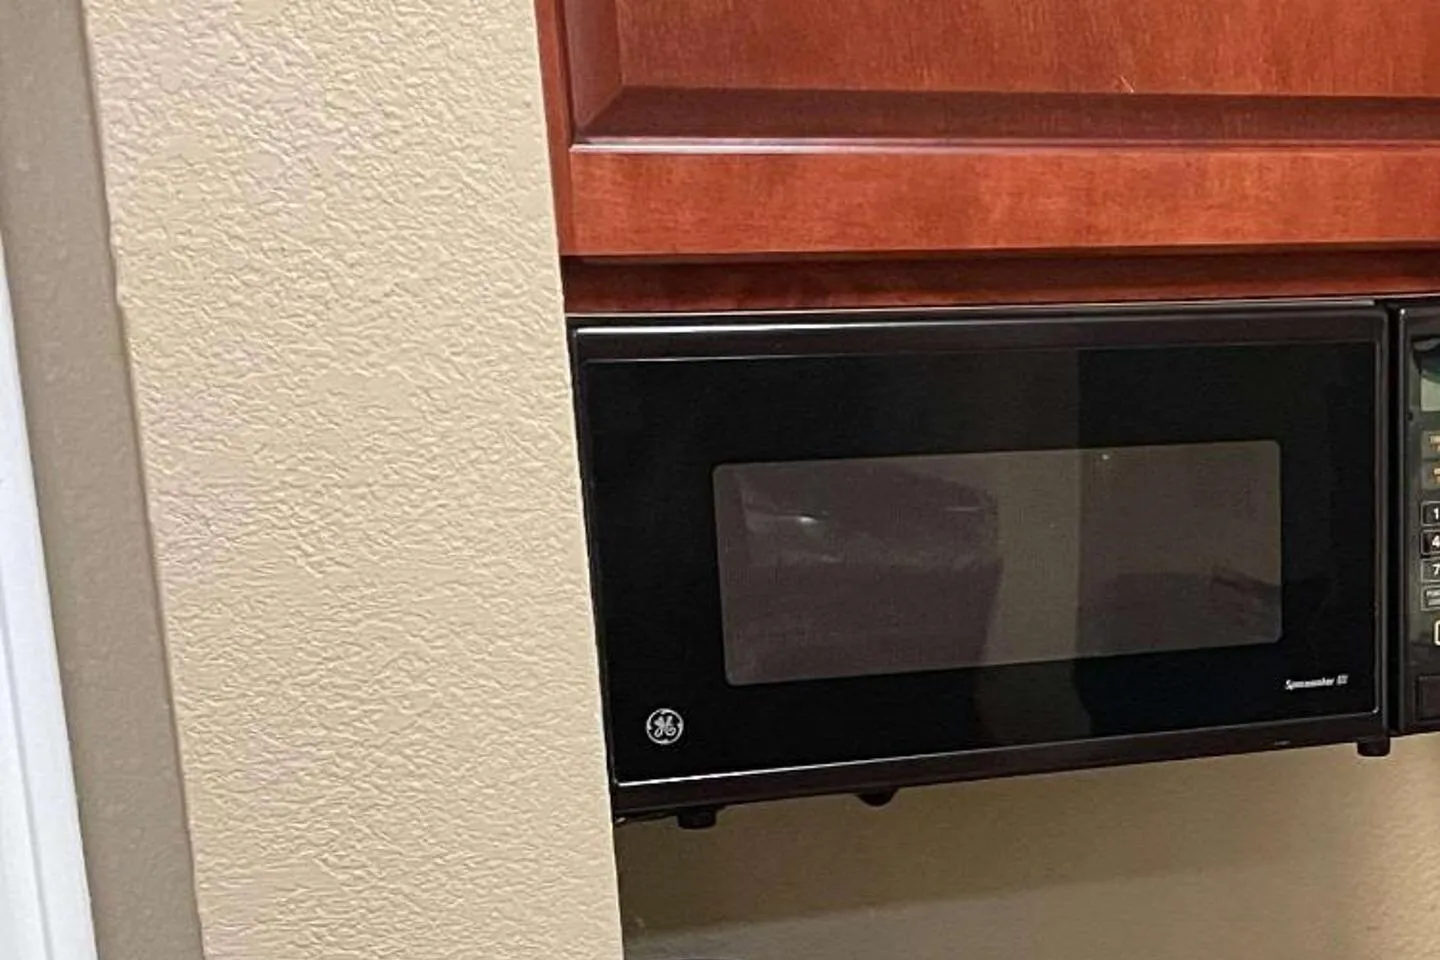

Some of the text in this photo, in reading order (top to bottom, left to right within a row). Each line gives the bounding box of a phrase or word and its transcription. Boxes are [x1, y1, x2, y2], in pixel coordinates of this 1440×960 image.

[1433, 507, 1440, 520] 1
[1432, 535, 1440, 548] 4
[1432, 563, 1440, 576] 7
